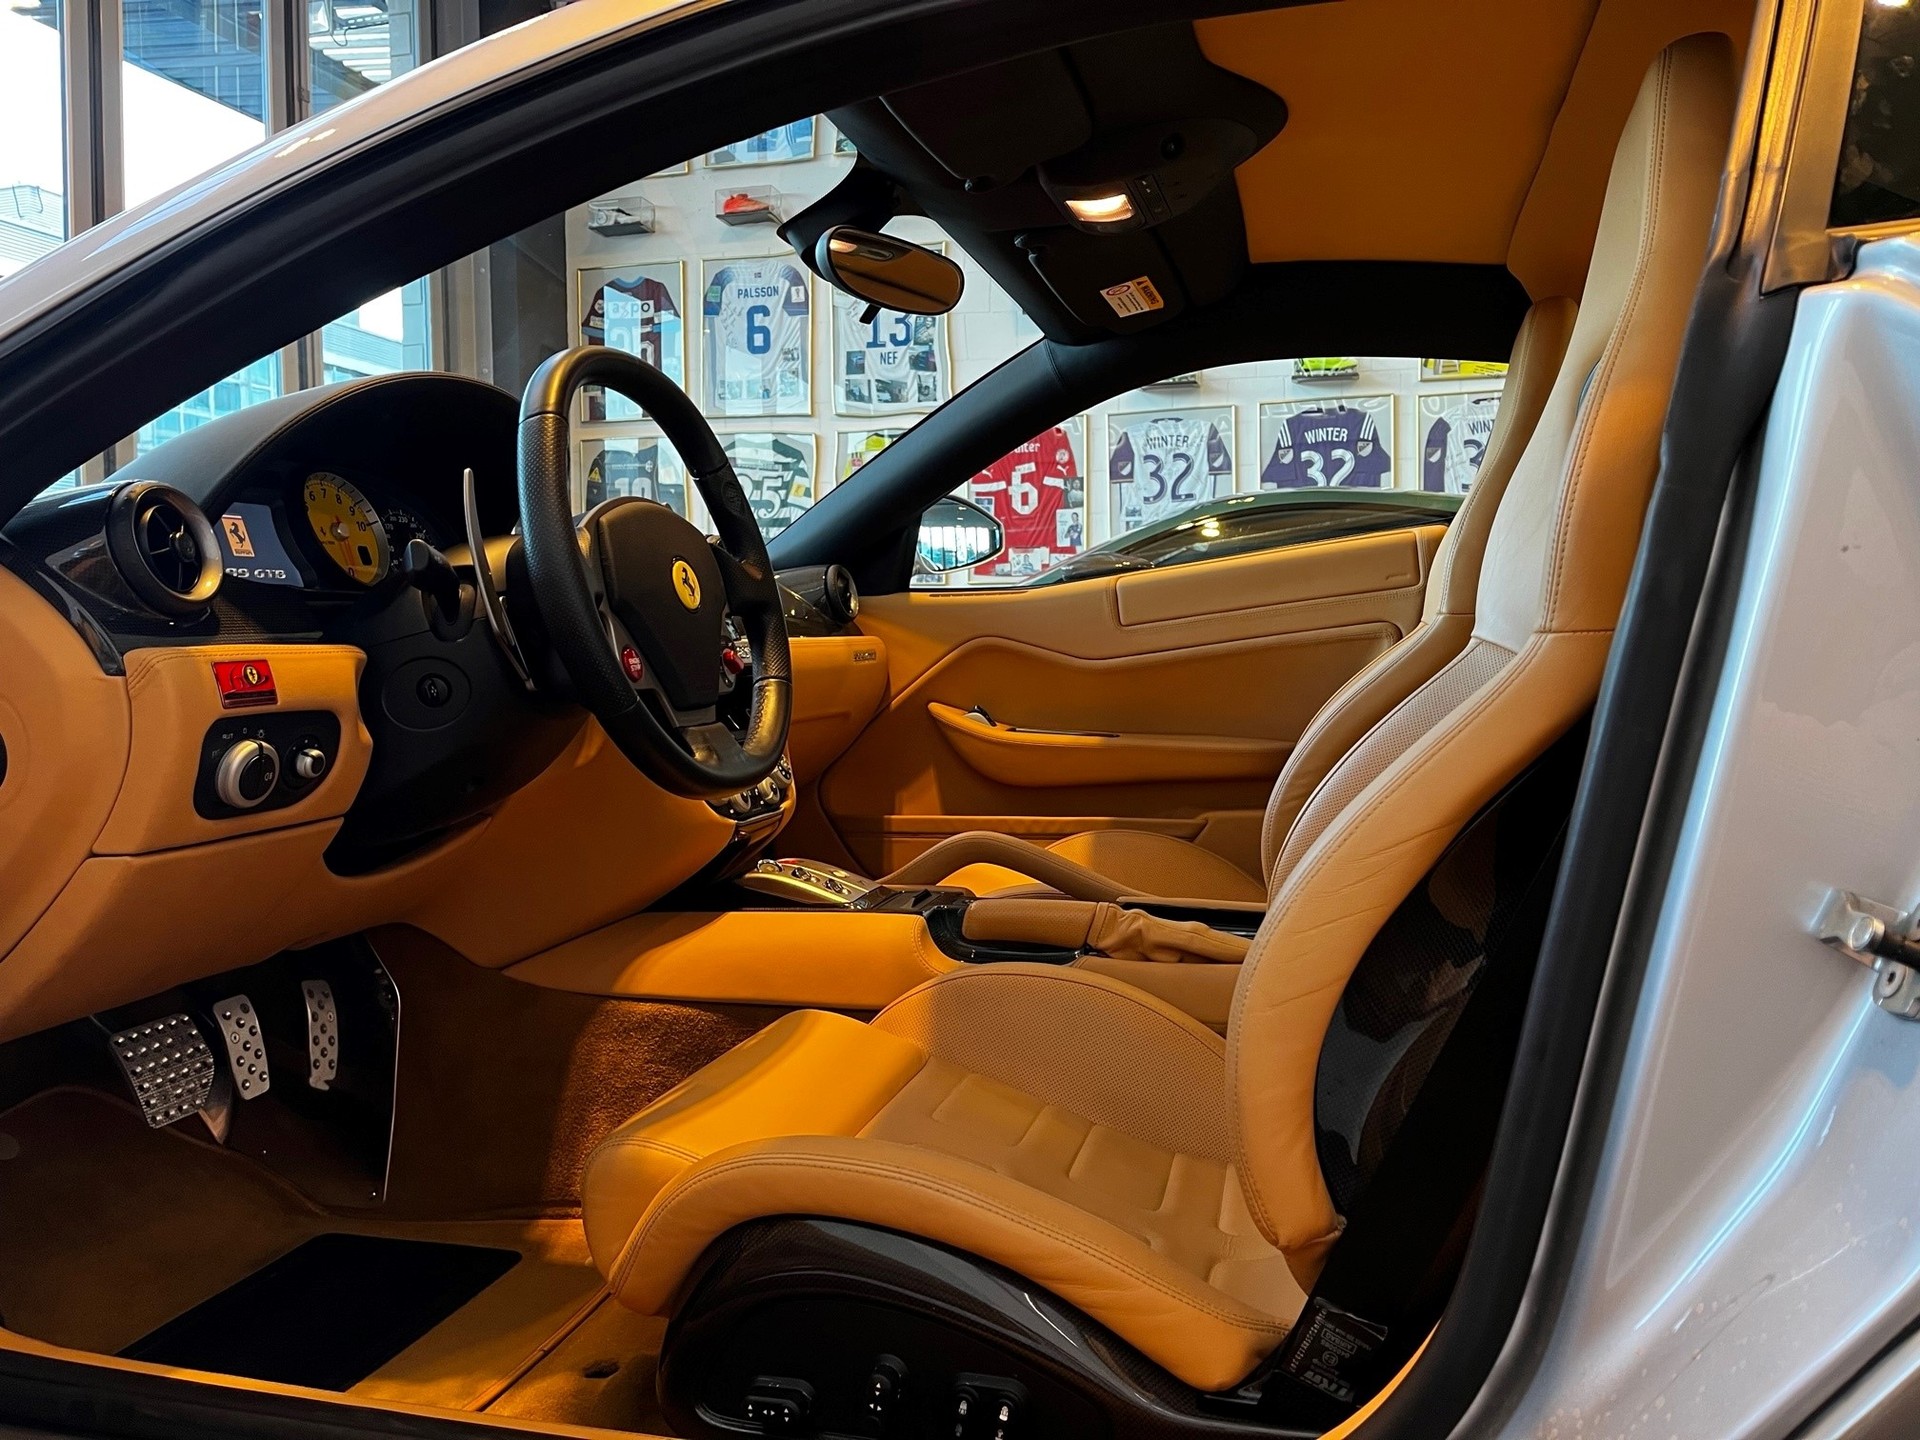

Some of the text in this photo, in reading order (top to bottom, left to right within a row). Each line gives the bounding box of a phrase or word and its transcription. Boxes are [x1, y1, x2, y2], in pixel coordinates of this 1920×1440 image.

[738, 286, 779, 299] PALSSON
[746, 304, 771, 355] 6
[866, 312, 913, 349] 13
[879, 351, 899, 365] NEF
[1145, 434, 1190, 450] WINTER
[1303, 427, 1349, 445] WINTER
[1300, 448, 1356, 487] 32
[1142, 452, 1197, 504] 32
[320, 488, 327, 499] 7
[1009, 462, 1039, 515] 6
[356, 521, 367, 532] 10
[225, 567, 250, 578] 99
